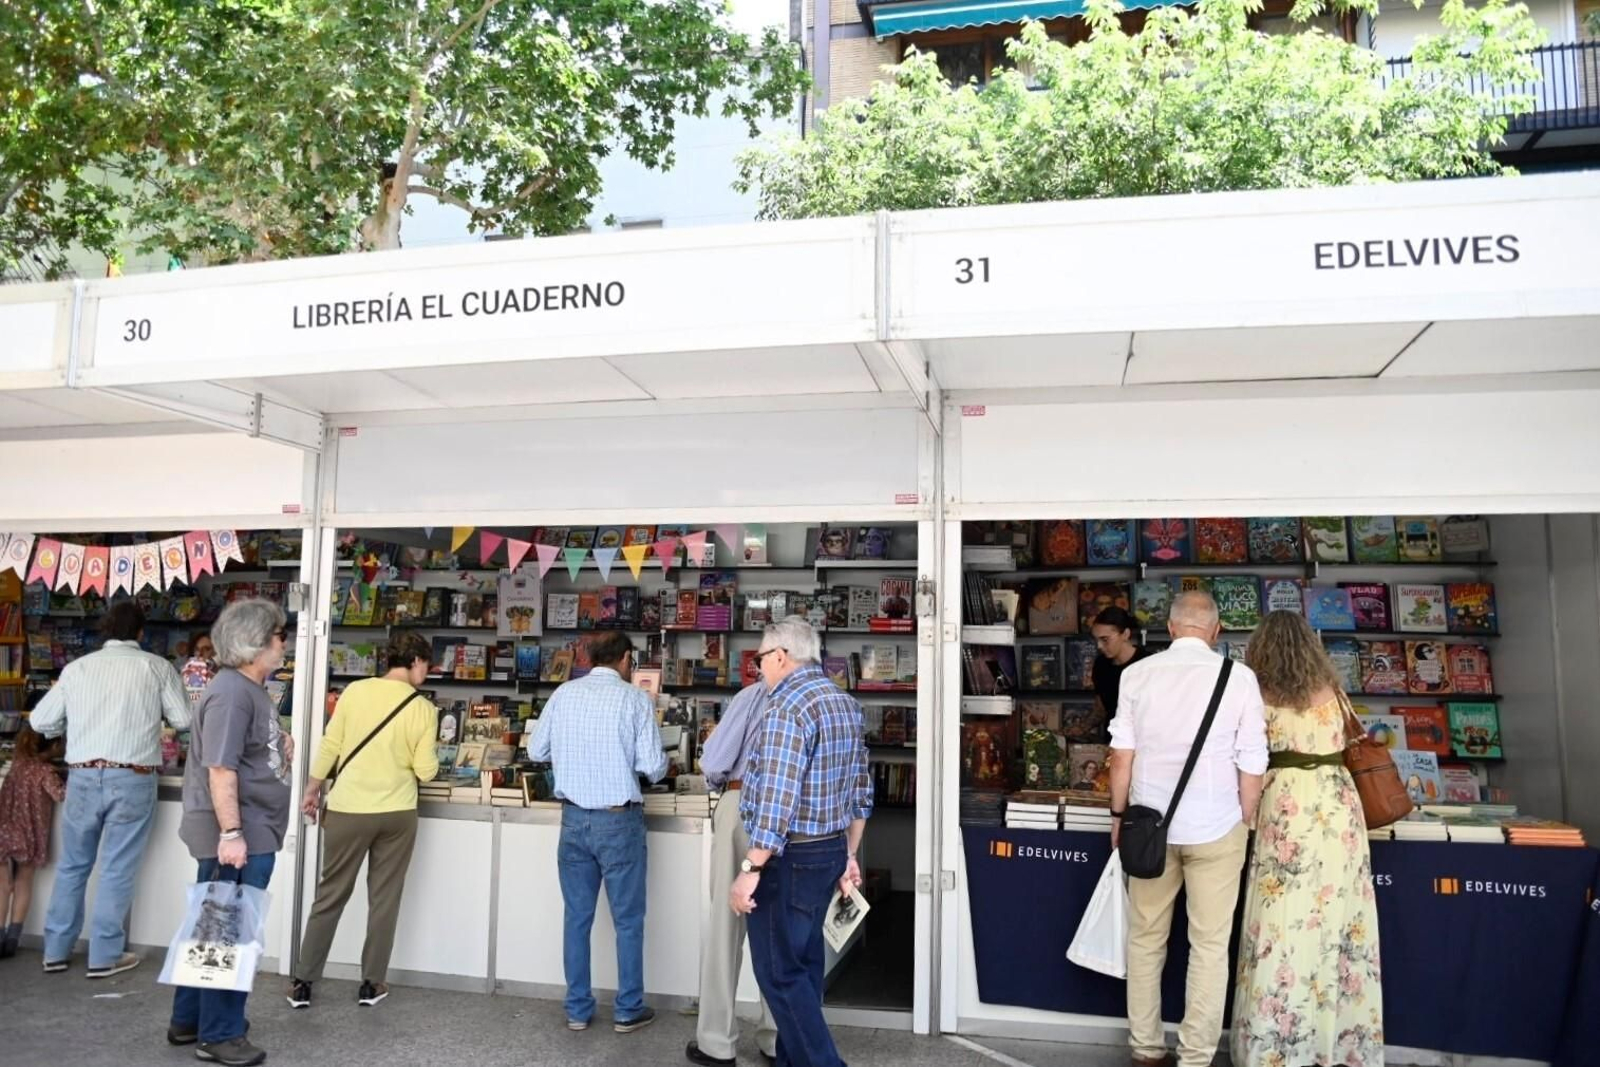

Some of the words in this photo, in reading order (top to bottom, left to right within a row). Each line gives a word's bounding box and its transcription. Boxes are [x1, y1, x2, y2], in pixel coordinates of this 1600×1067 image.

[1314, 234, 1520, 270] EDELVIVES
[955, 257, 991, 285] 31
[293, 291, 413, 329] LIBRERÍA
[422, 294, 453, 320] EL
[461, 281, 625, 318] CUADERNO
[122, 318, 151, 342] 30
[1219, 600, 1257, 613] VIAJE
[1228, 591, 1258, 602] LOCO
[1018, 845, 1089, 863] EDELVIVES
[1465, 880, 1546, 898] EDELVIVES
